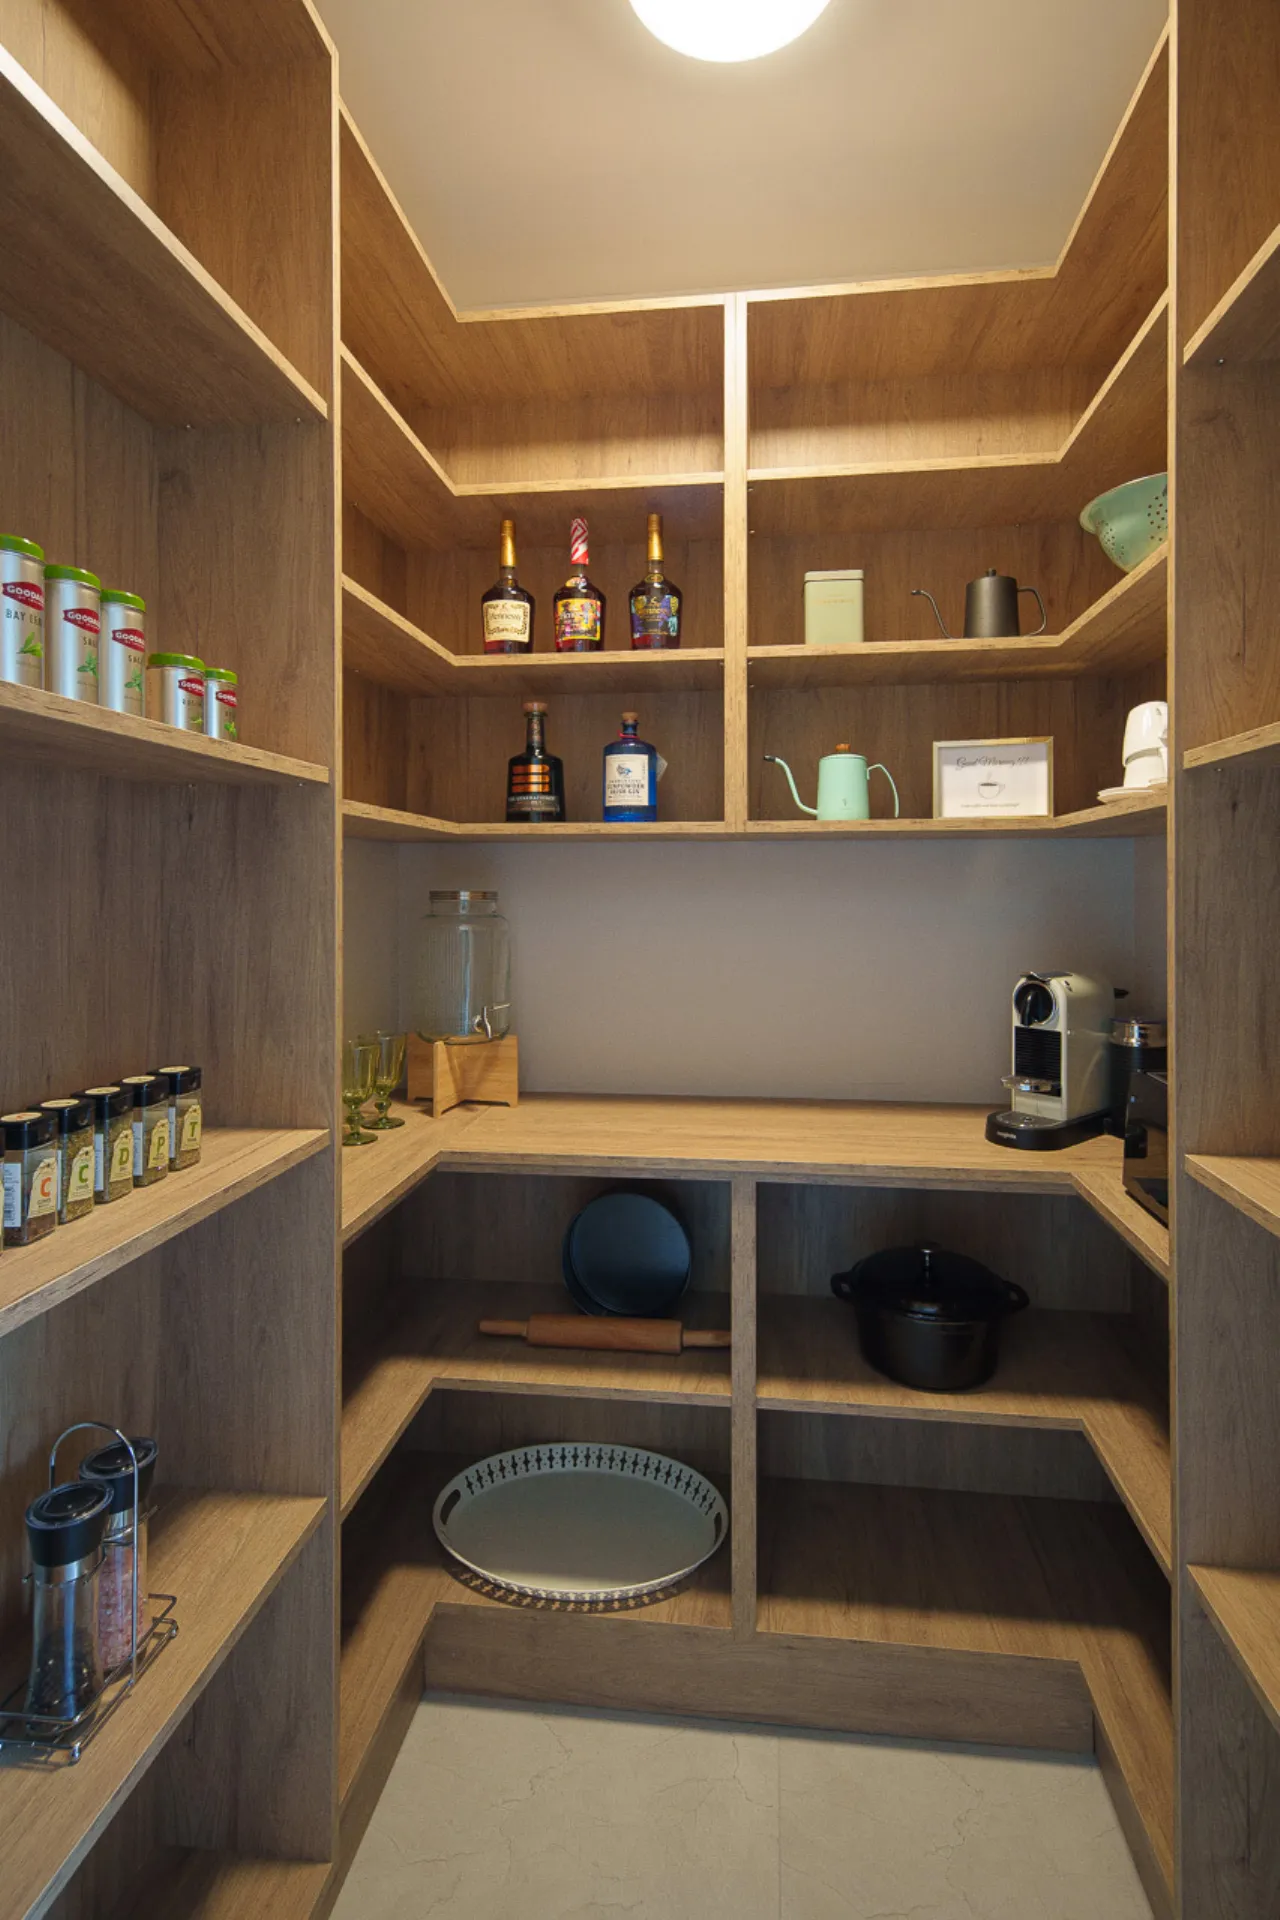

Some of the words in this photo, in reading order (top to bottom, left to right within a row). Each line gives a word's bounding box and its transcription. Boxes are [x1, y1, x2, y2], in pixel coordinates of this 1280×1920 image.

[5, 608, 26, 620] BAY
[190, 1121, 198, 1137] T
[157, 1136, 165, 1154] P
[118, 1147, 129, 1165] D
[79, 1164, 88, 1184] C
[40, 1177, 52, 1198] C
